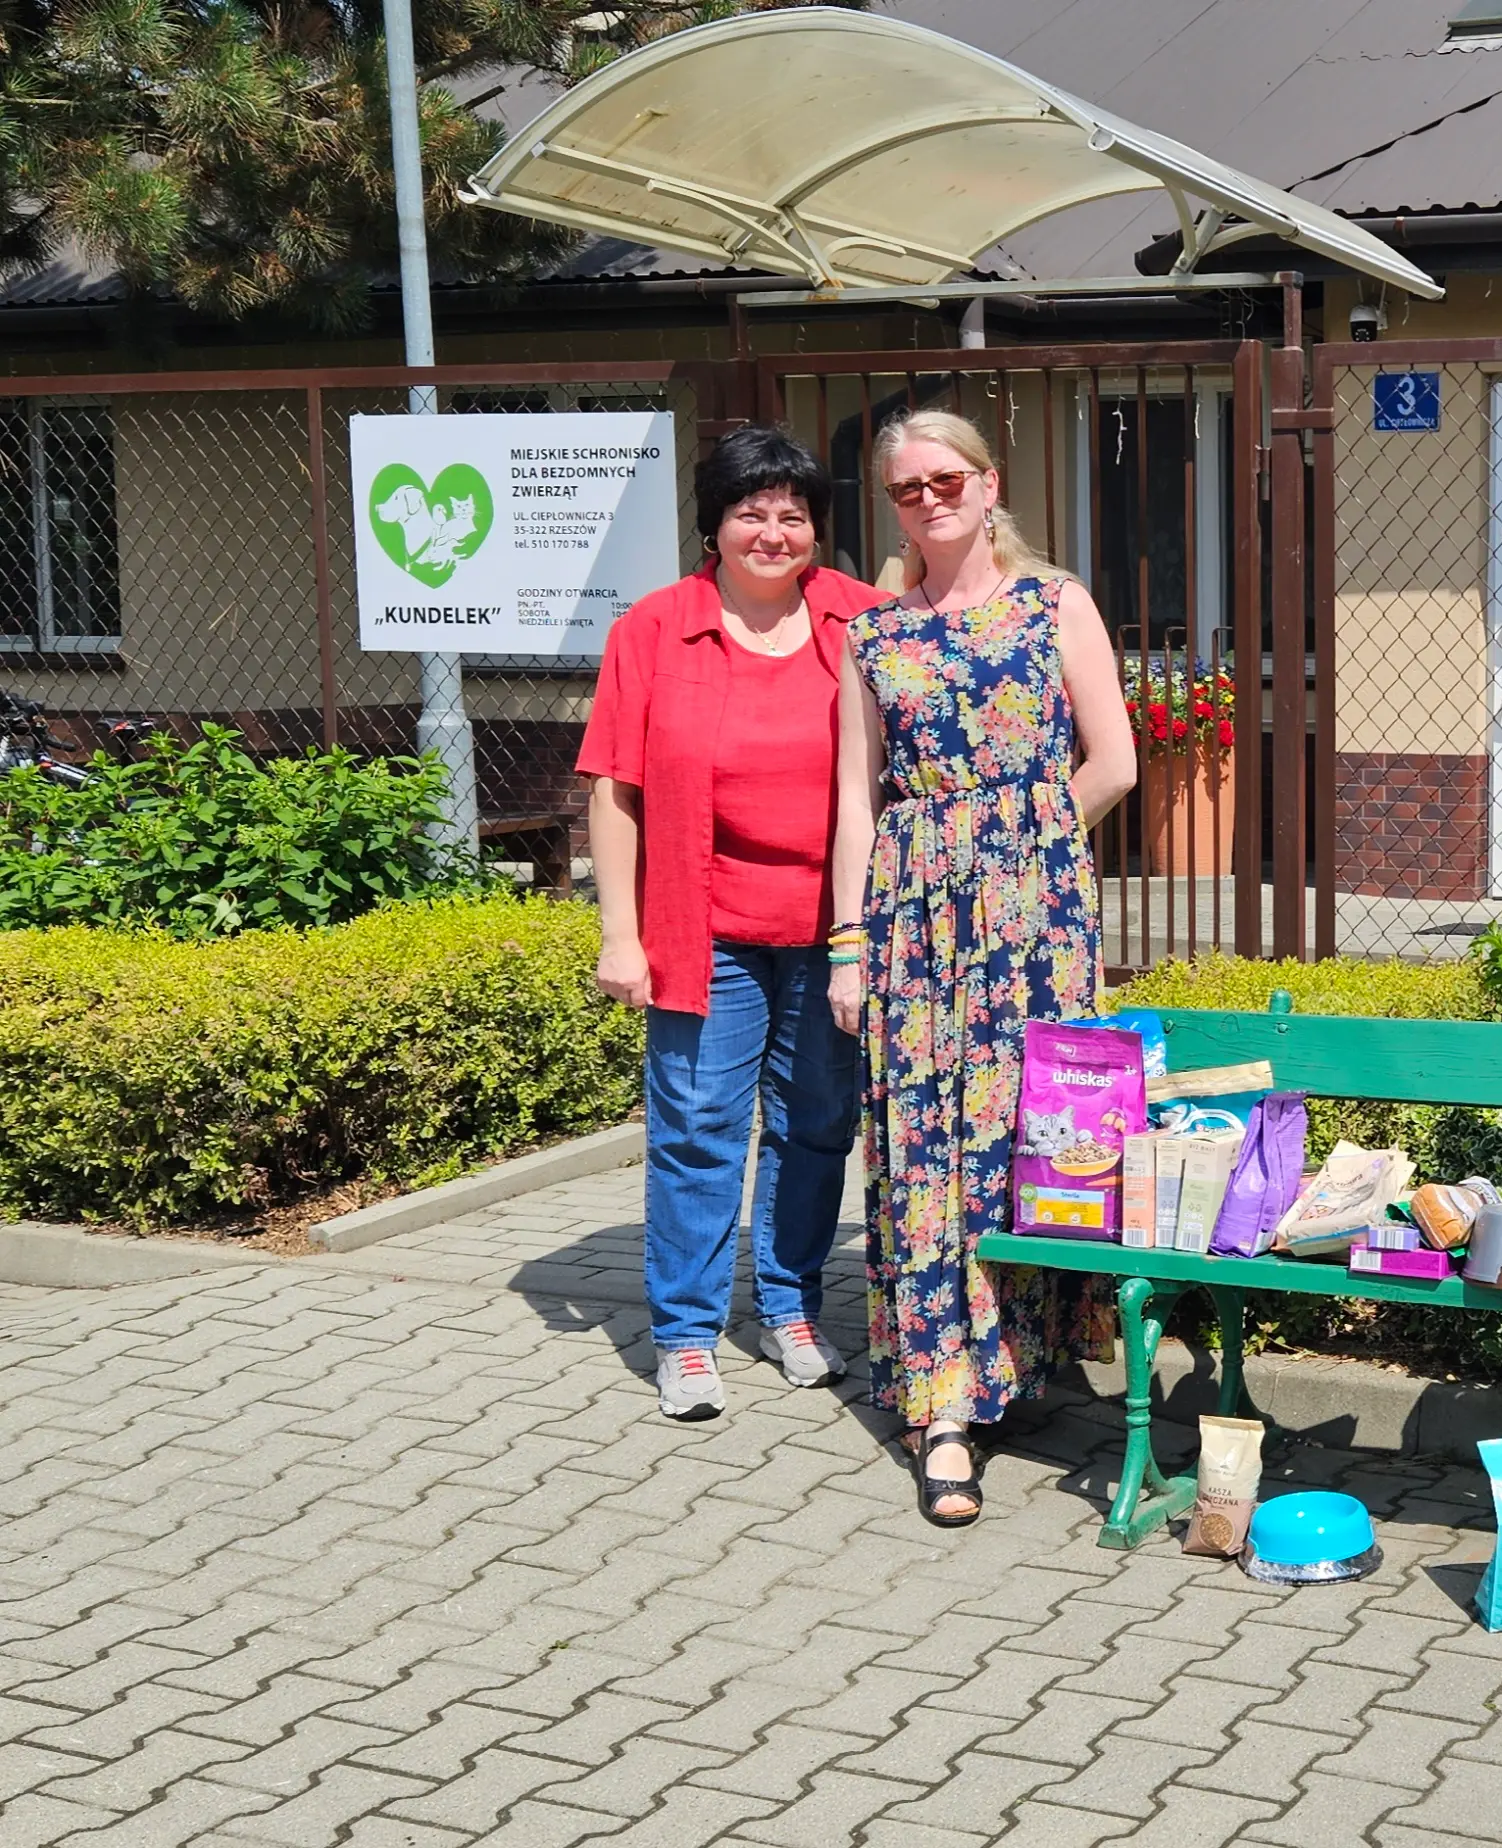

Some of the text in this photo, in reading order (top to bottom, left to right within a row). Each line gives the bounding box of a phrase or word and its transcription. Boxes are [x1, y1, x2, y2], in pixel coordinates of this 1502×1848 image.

[1397, 376, 1416, 415] 3
[511, 447, 660, 460] MIEJSKIE SCHRONISKO
[512, 466, 636, 478] DLA BEZDOMNYCH
[512, 485, 578, 500] ZWIERZĄT
[513, 511, 614, 521] UL. CIEPŁOWNICZA 3
[514, 524, 597, 535] 35-322 RZESZÓW
[515, 540, 589, 549] tel. 510 170 788
[517, 588, 618, 598] GODZINY OTWARCIA
[518, 618, 559, 626] NIEDZIELE
[564, 617, 594, 628] ŚWIĘTA
[1052, 1068, 1113, 1087] whiskas
[1208, 1487, 1232, 1497] KASZA
